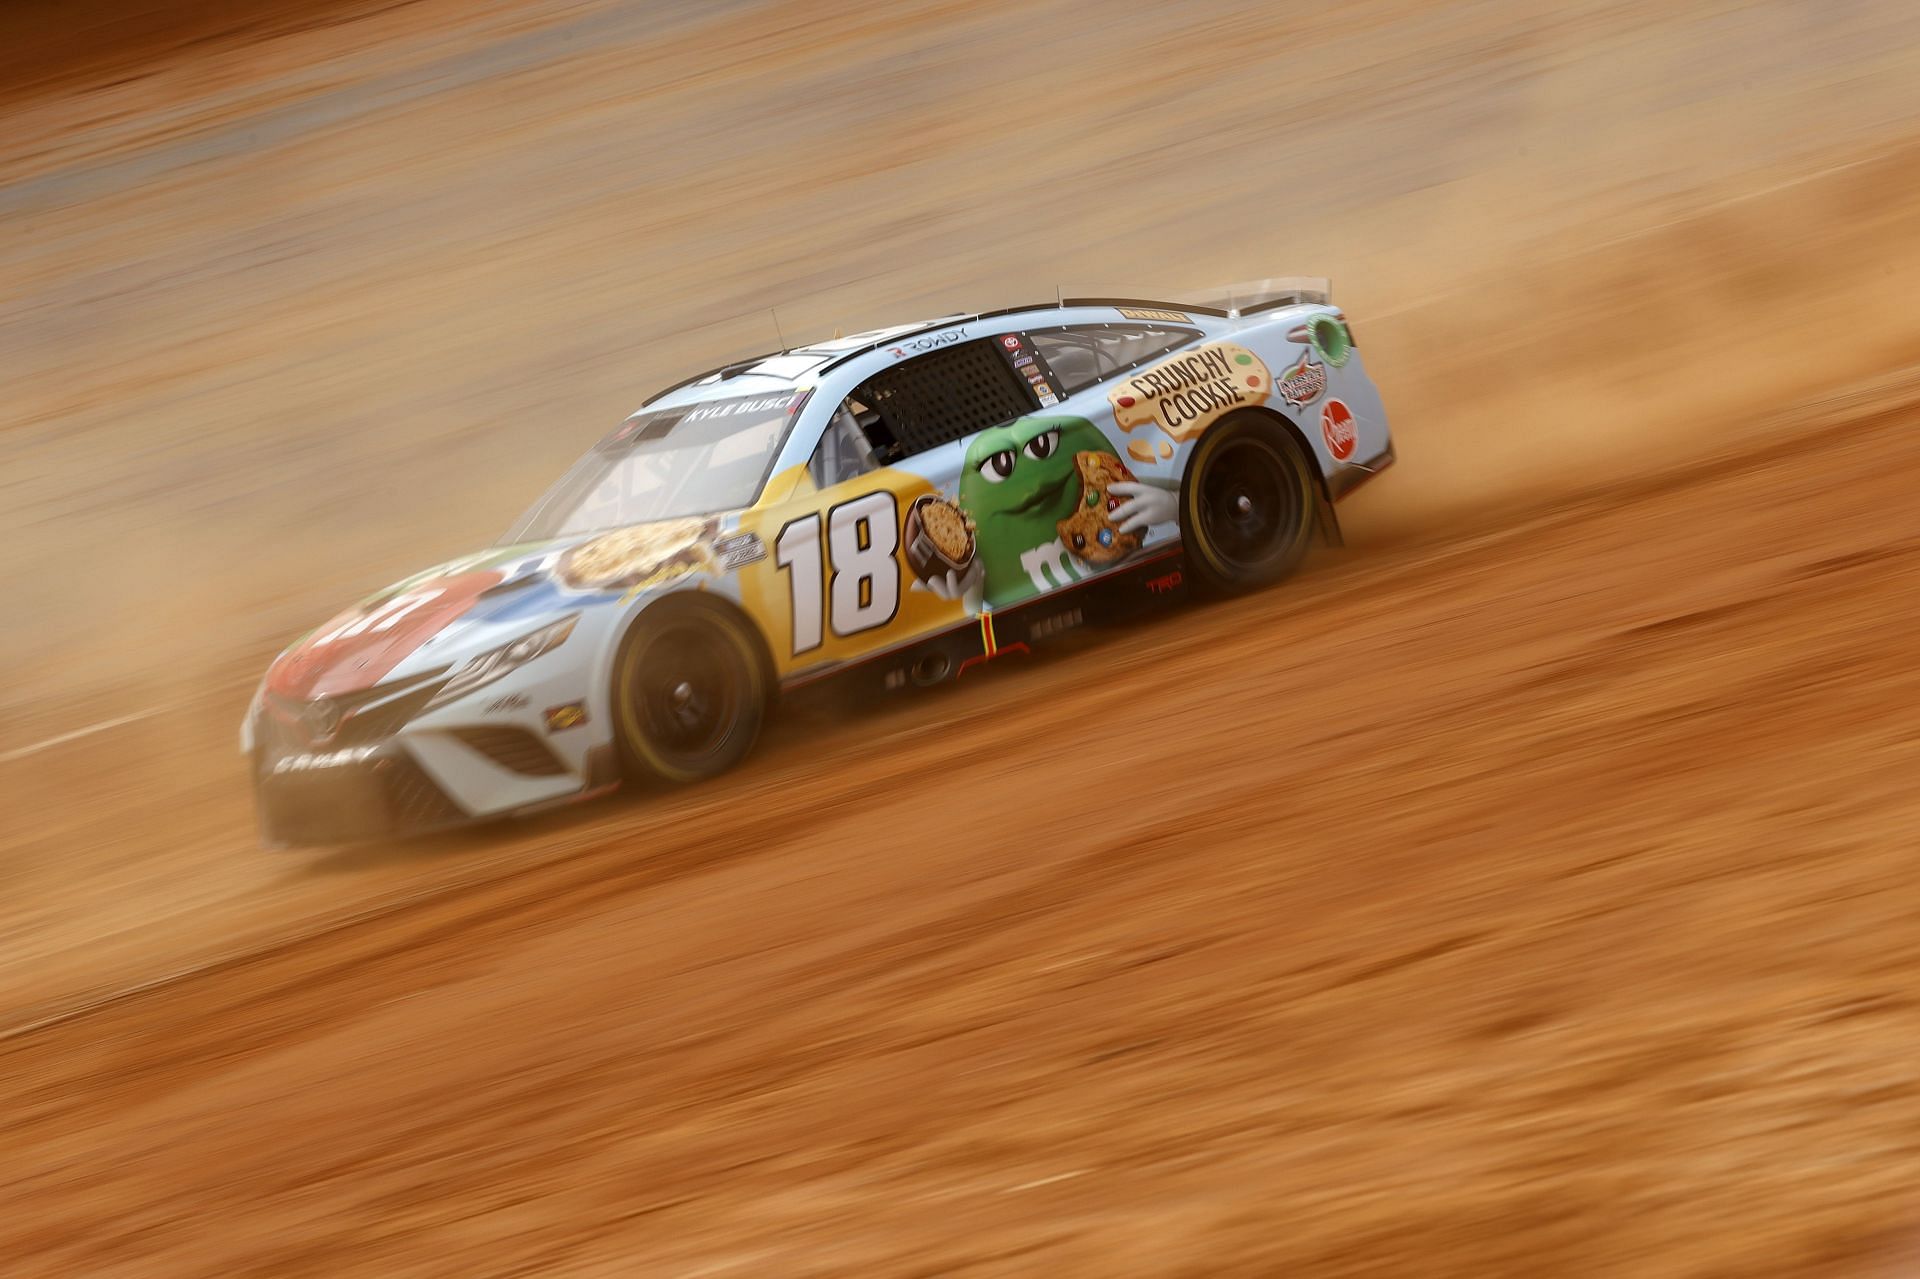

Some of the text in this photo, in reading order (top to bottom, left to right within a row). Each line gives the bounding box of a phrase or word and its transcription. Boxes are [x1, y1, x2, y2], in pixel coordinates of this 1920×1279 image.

[903, 327, 968, 351] ROWDY
[1130, 347, 1233, 399] CRUNCHY
[684, 403, 737, 423] KYLE
[1159, 377, 1245, 427] COOKIE
[775, 490, 901, 656] 18
